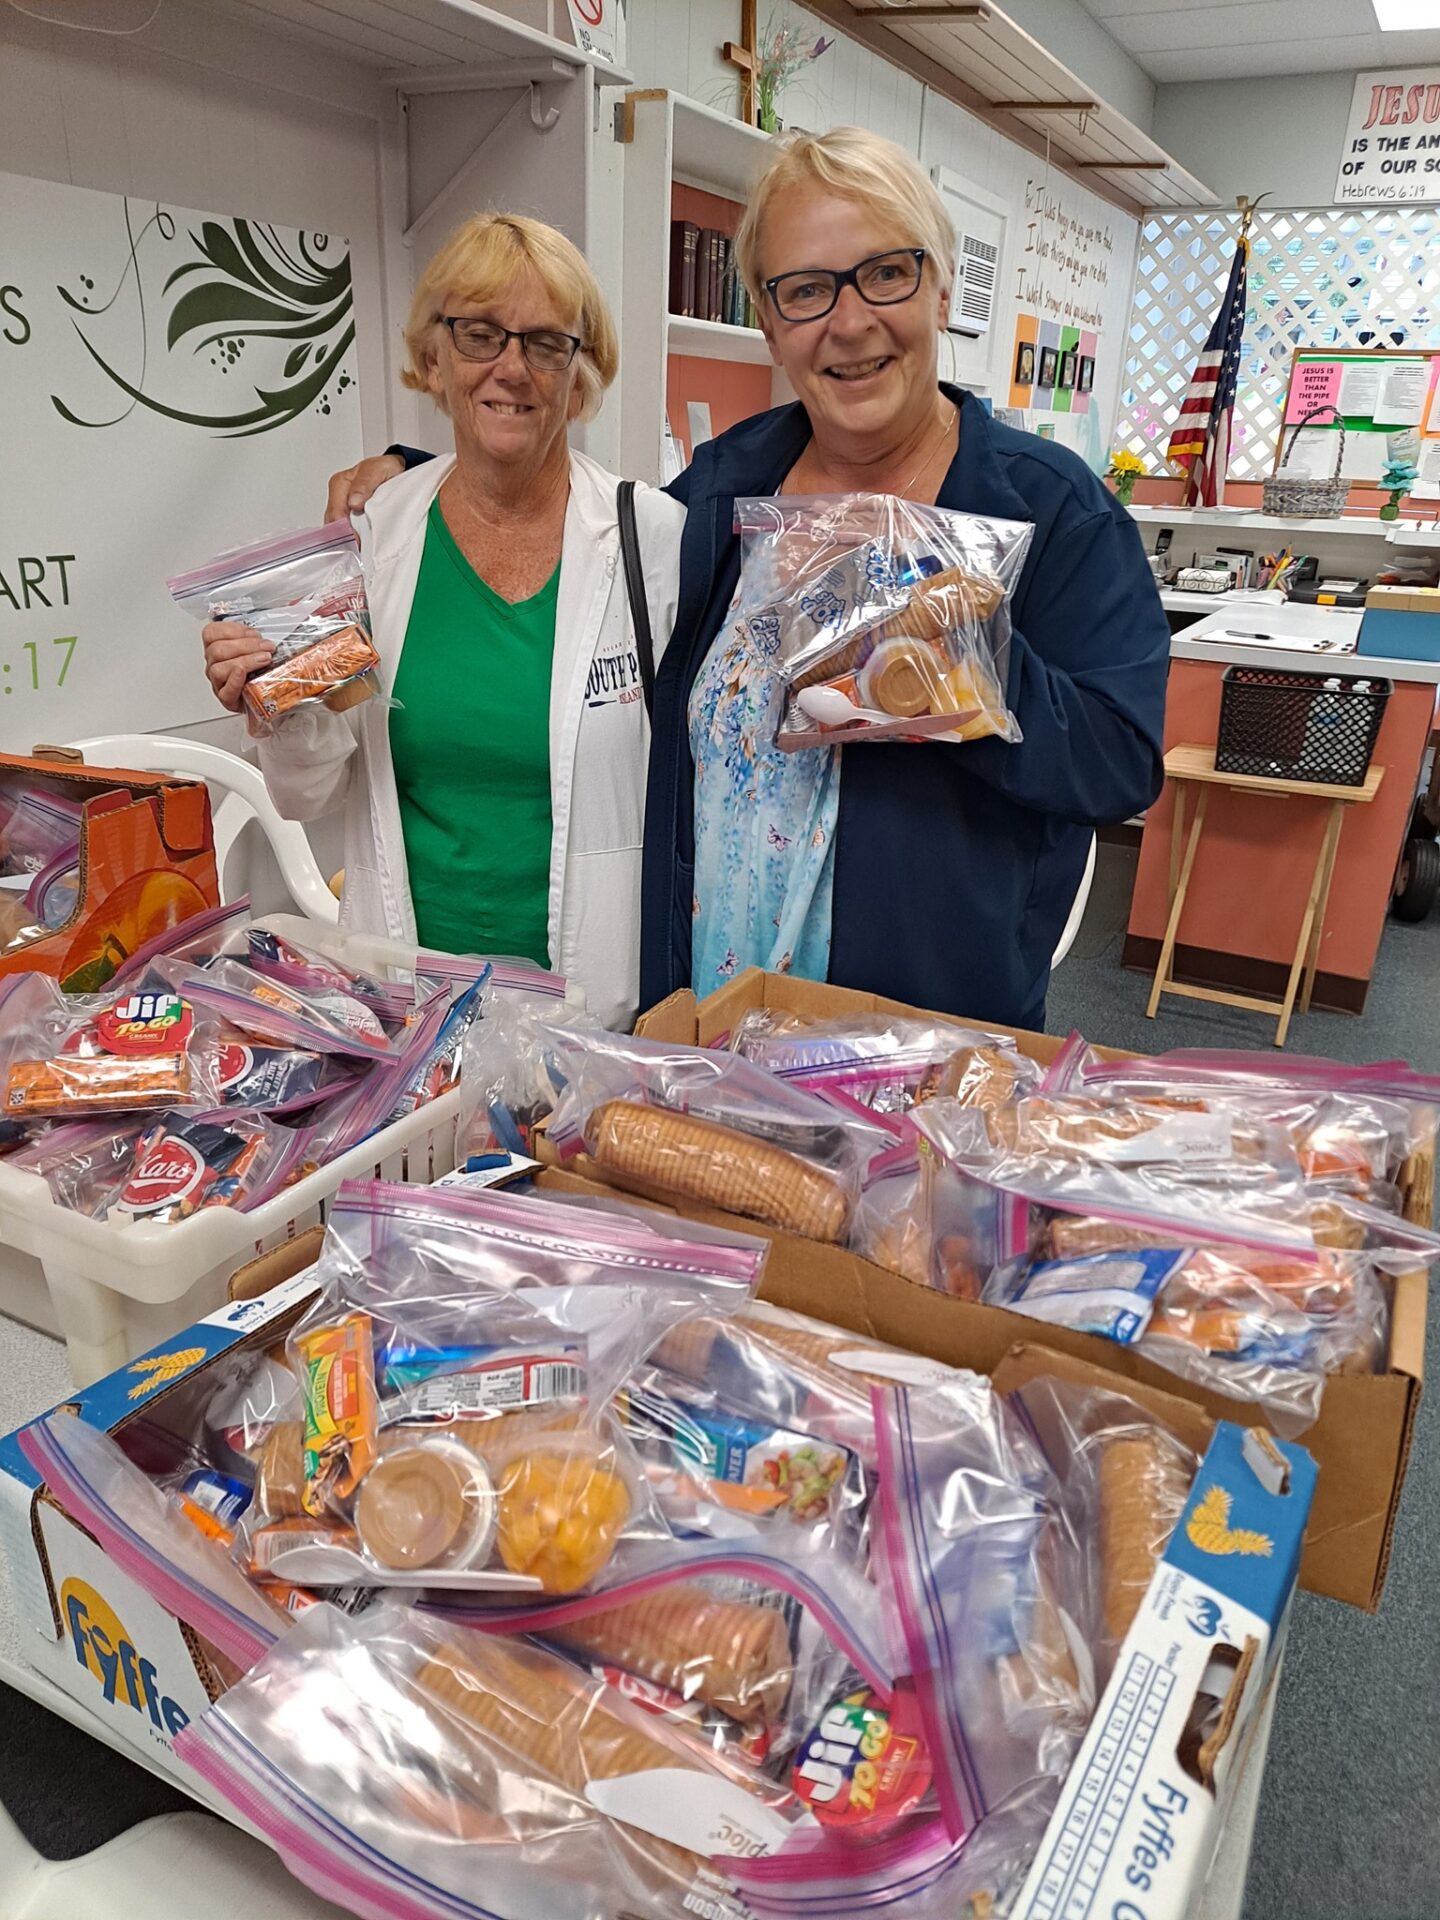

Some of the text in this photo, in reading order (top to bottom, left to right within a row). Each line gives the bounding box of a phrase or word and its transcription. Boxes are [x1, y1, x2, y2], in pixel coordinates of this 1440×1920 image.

[579, 28, 590, 42] NO
[1352, 138, 1368, 153] IS
[1377, 136, 1411, 152] THE
[1342, 161, 1365, 175] OF
[1380, 159, 1417, 174] OUR
[1025, 222, 1037, 252] I
[1015, 267, 1027, 299] I
[116, 993, 179, 1019] Jif
[115, 1015, 177, 1037] TO GO
[729, 1446, 743, 1483] ATER
[1133, 1663, 1146, 1676] 11
[1157, 1679, 1168, 1688] 1
[1123, 1690, 1135, 1704] 12
[1147, 1705, 1158, 1715] 2
[1111, 1718, 1124, 1731] 13
[1135, 1733, 1148, 1744] 3
[799, 1707, 864, 1802] Jif
[1099, 1747, 1112, 1761] 14
[850, 1718, 889, 1809] TO GO
[1125, 1764, 1136, 1774] 4
[1085, 1777, 1100, 1792] 15
[1111, 1794, 1124, 1805] 5
[1073, 1809, 1087, 1825] 16
[1099, 1827, 1111, 1839] 6
[1125, 1779, 1189, 1892] Fyffes
[1059, 1842, 1074, 1861] 17
[1086, 1861, 1099, 1874] 7
